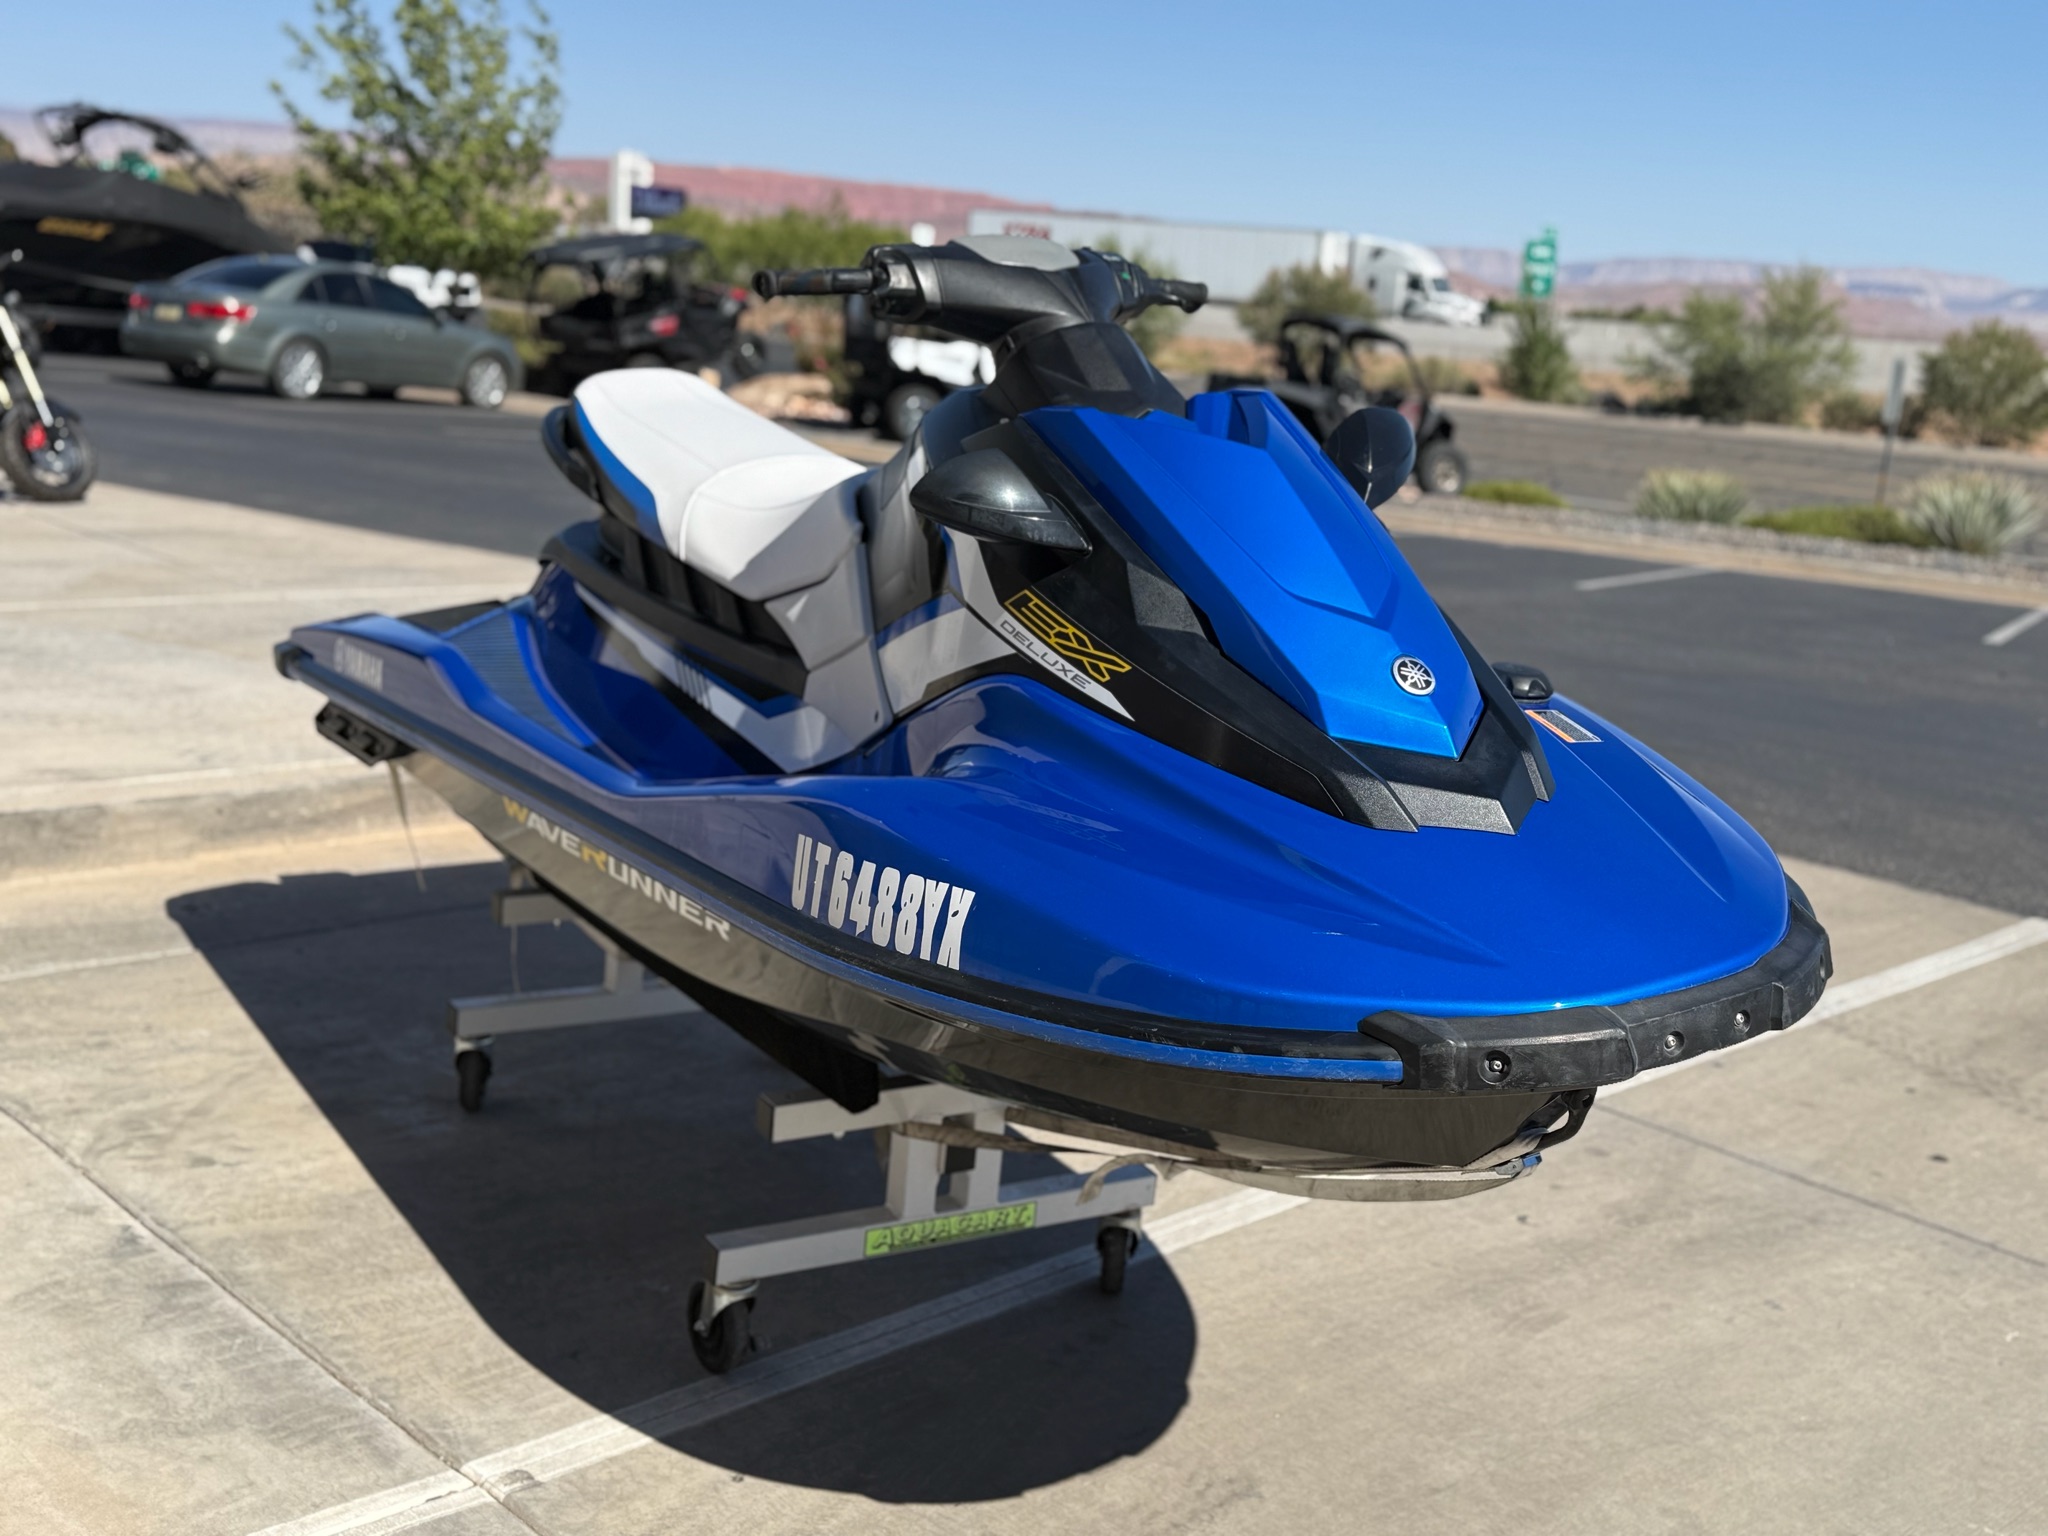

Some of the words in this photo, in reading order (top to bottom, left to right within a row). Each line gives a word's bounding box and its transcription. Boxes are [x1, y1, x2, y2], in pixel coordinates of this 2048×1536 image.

[1000, 619, 1092, 690] DELUXE
[1004, 589, 1132, 683] EX
[501, 796, 731, 941] WAVERUNNER
[791, 834, 976, 970] UT6488YX
